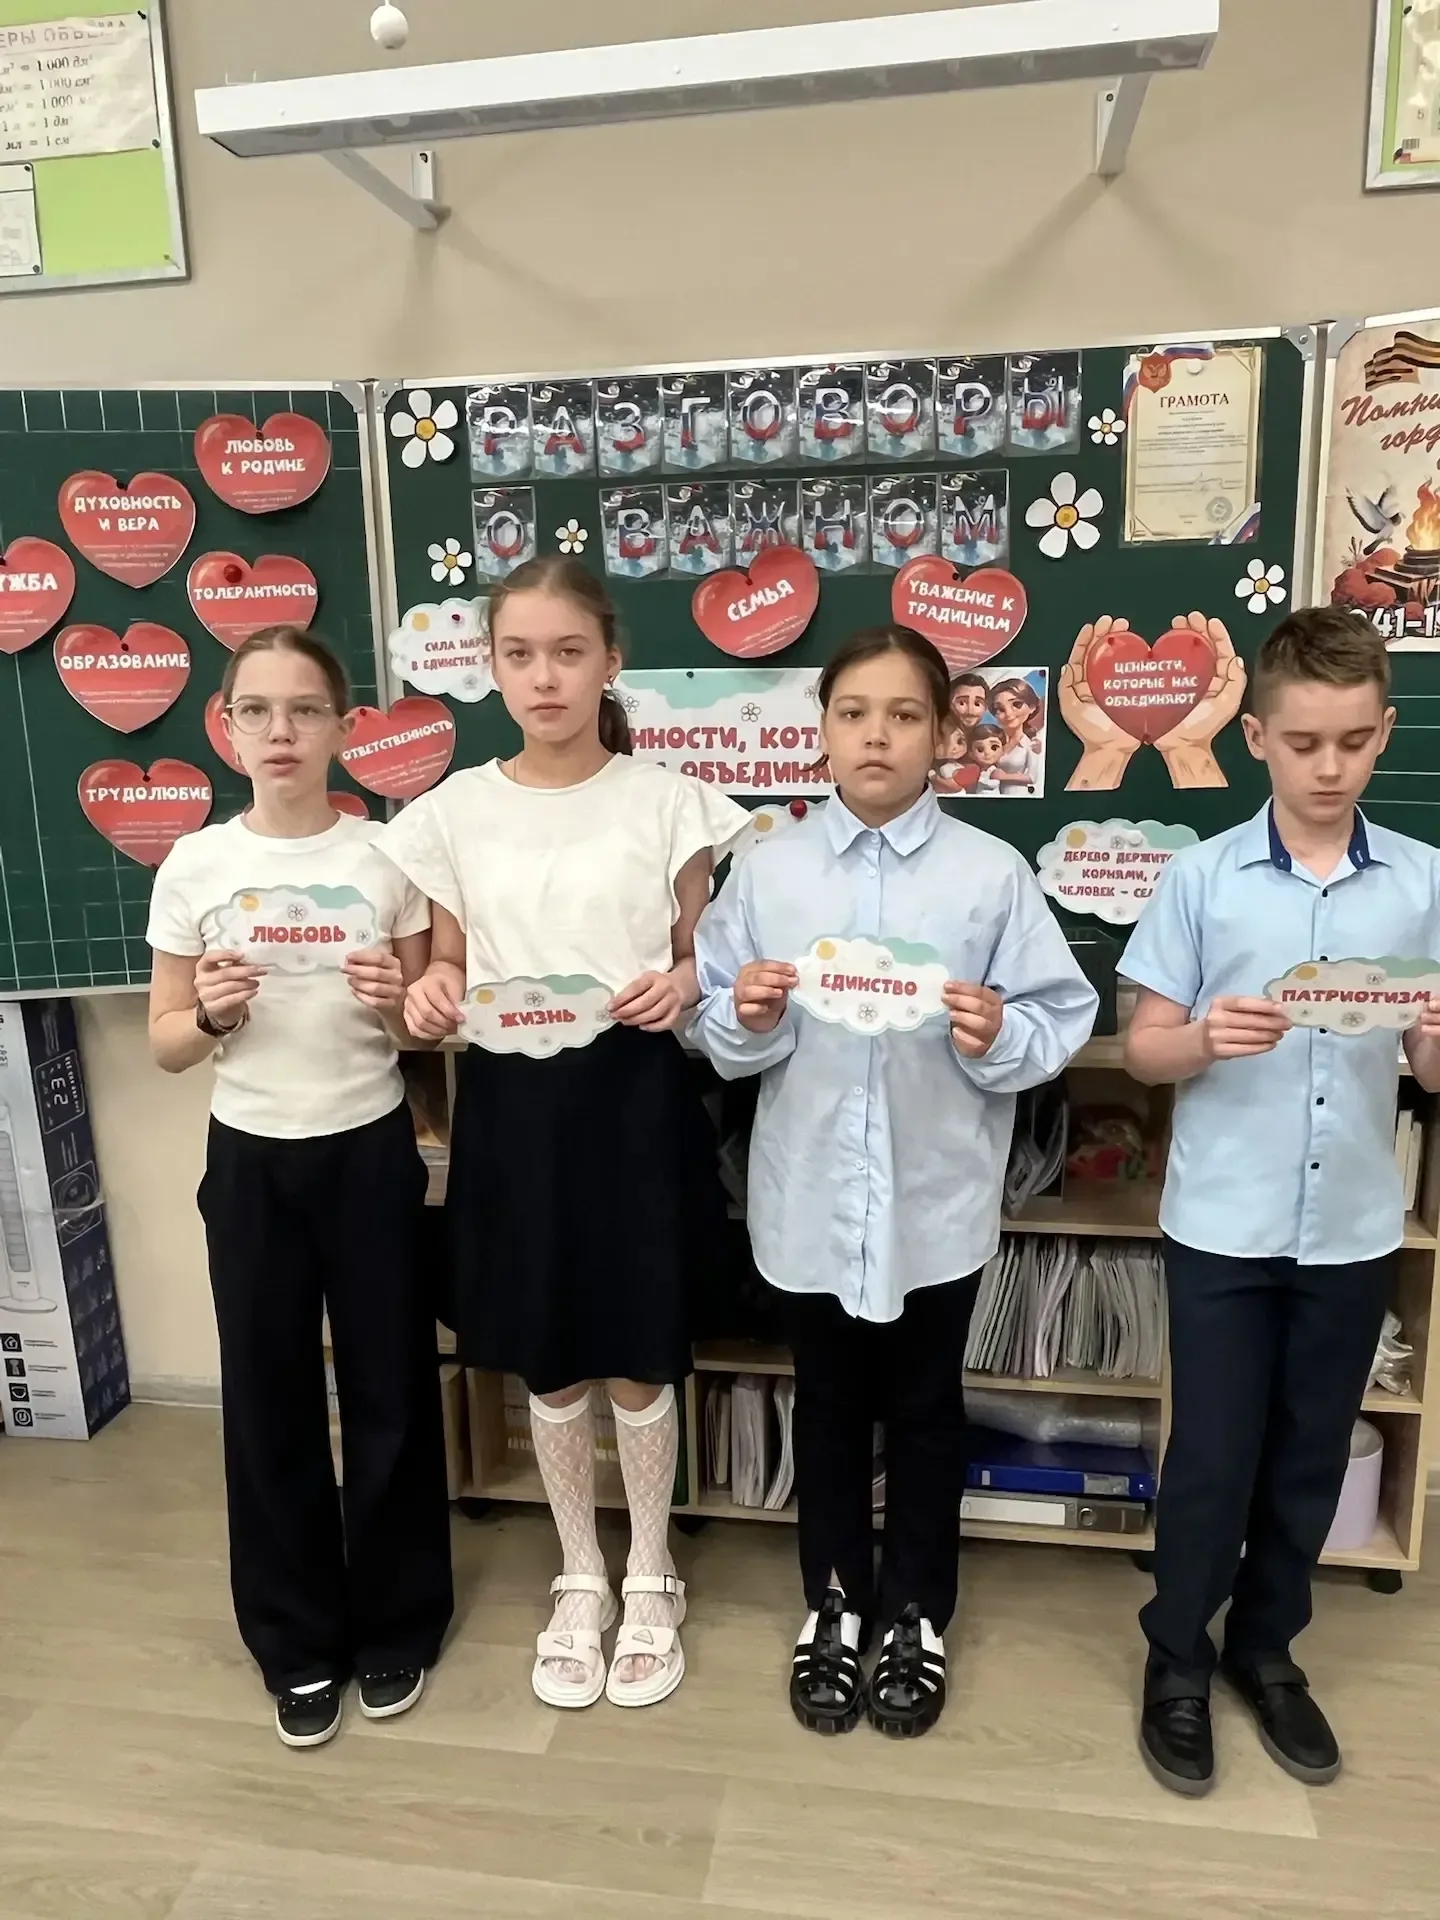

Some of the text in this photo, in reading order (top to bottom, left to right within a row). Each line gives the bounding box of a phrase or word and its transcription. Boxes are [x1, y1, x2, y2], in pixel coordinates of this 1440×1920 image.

[1160, 393, 1229, 408] ГРАМОТА
[483, 374, 1066, 456] РАЗГОВОРЫ
[225, 438, 295, 455] ЛЮБОВЬ
[221, 458, 306, 475] К РОДИНЕ
[74, 495, 183, 514] ДУХОВНОСТЬ
[98, 517, 160, 532] И ВЕРА
[487, 494, 998, 558] О ВАЖНОМ
[193, 583, 317, 601] ТОЛЕРАНТНОСТЬ
[727, 579, 795, 622] СЕМЬЯ
[909, 579, 1015, 612] УВАЖЕНИЕ К
[907, 600, 1012, 632] ТРАДИЦИЯМ
[424, 640, 456, 652] СИЛА
[60, 652, 190, 671] ОБРАЗОВАНИЕ
[411, 661, 419, 671] В
[423, 655, 477, 671] ЕДИНСТВЕ
[1114, 660, 1187, 674] ЦЕННОСТИ,
[1103, 676, 1199, 690] КОТОРЫЕ НАС
[1104, 693, 1196, 707] ОБЪЕДИНЯЮТ
[341, 719, 454, 761] ОТВЕТСТВЕННОСТЬ
[86, 786, 211, 803] ТРУДОЛЮБИЕ
[1063, 851, 1110, 862] ДЕРЕВО
[1082, 868, 1147, 882] КОРНЯМИ,
[1058, 885, 1115, 897] ЧЕЛОВЕК
[249, 925, 347, 944] ЛЮБОВЬ
[820, 973, 918, 997] ЕДИНСТВО
[1282, 989, 1431, 1004] ПАТРИОТИЗМ
[498, 1008, 576, 1028] ЖИЗНЬ
